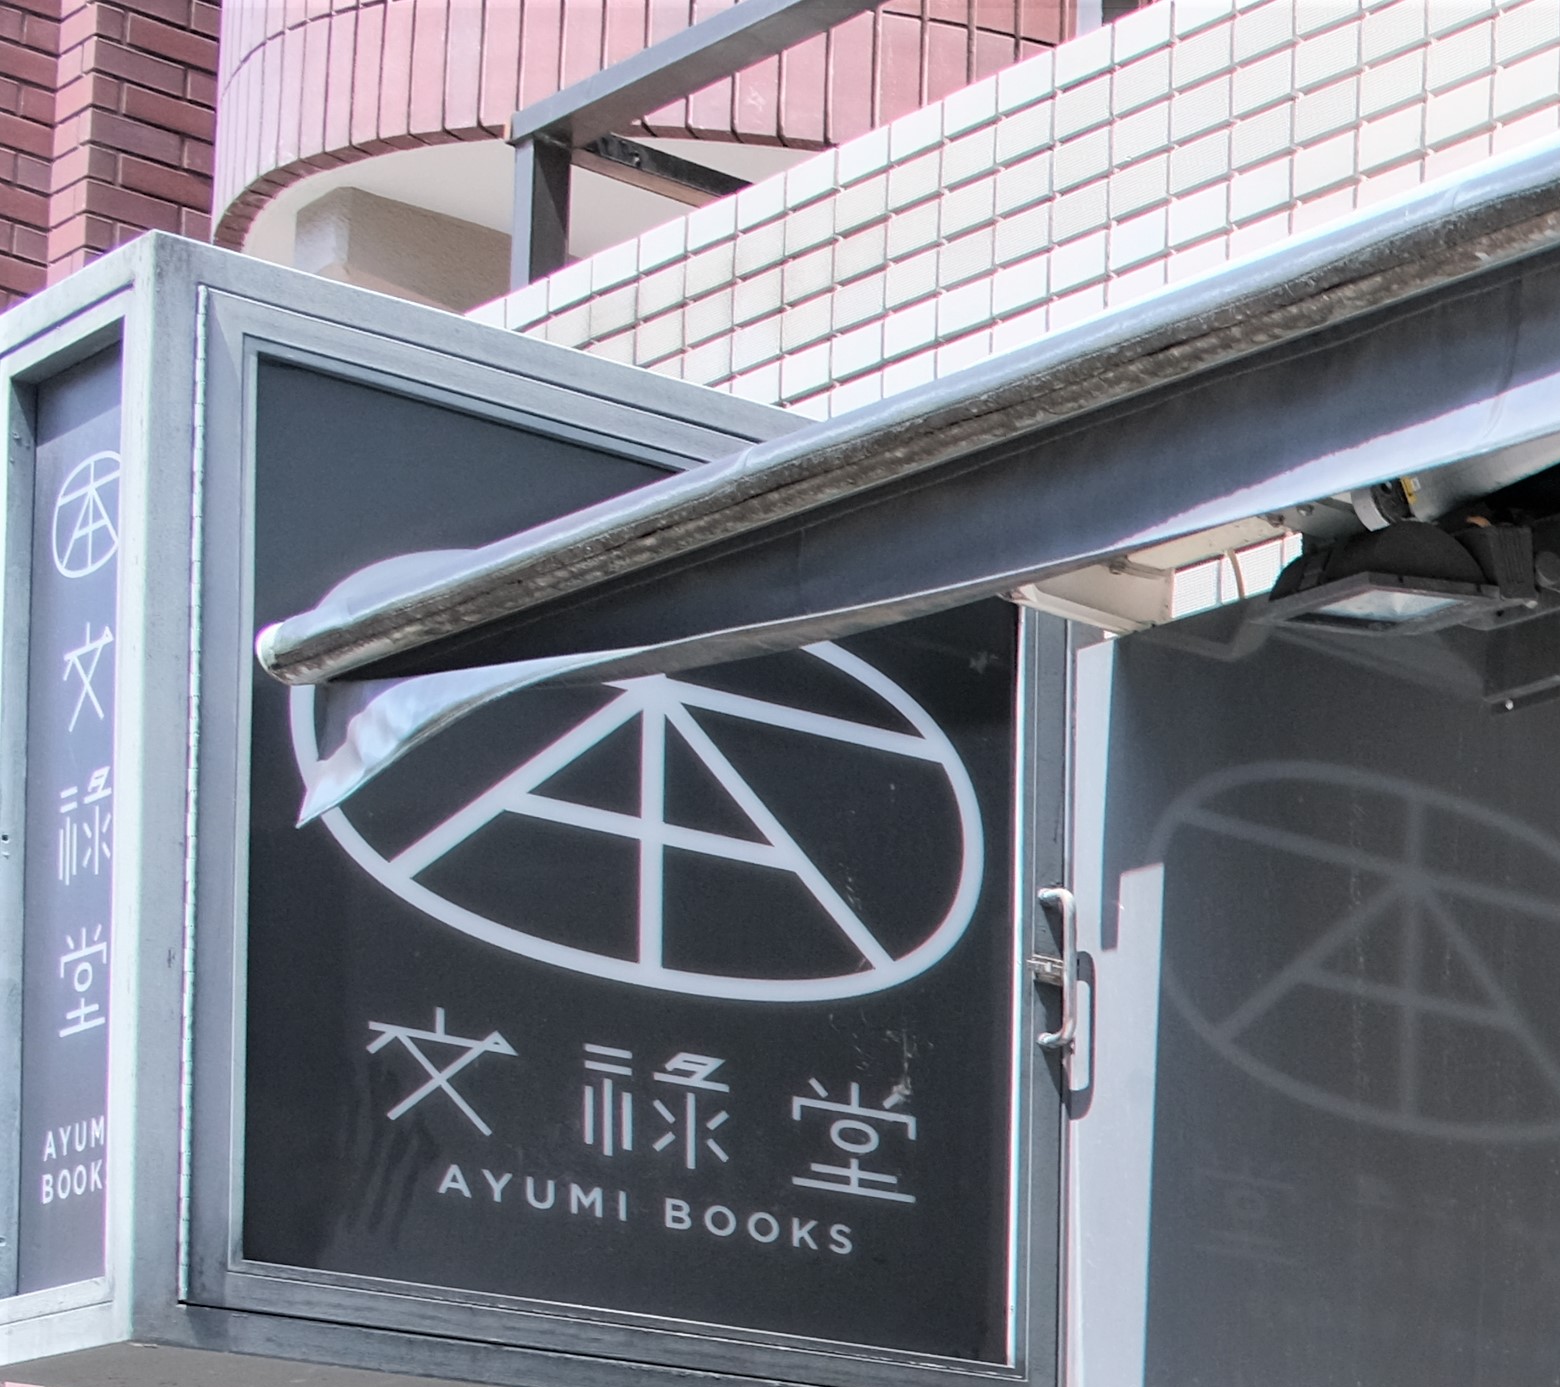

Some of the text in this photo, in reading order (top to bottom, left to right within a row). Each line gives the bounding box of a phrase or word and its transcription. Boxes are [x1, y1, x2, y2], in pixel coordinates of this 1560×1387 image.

[367, 1008, 918, 1203] 文禄堂
[438, 1164, 855, 1255] AYUMI BOOKS
